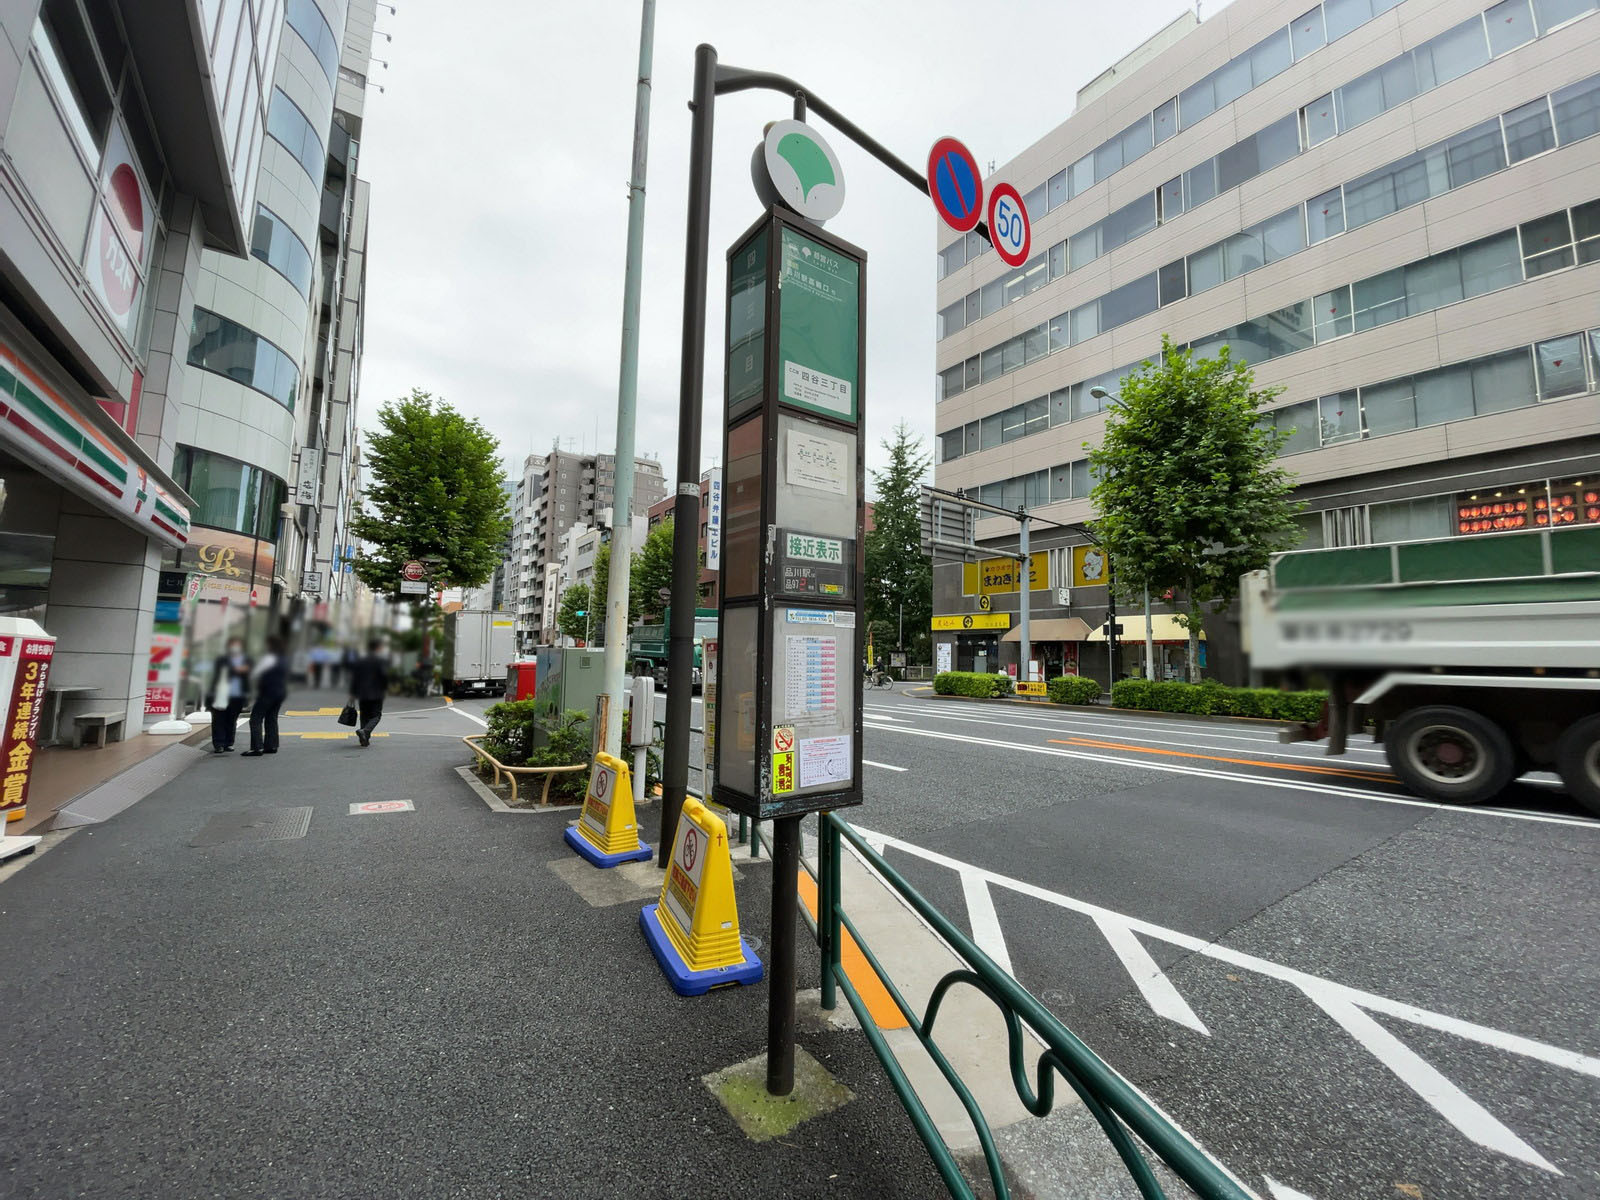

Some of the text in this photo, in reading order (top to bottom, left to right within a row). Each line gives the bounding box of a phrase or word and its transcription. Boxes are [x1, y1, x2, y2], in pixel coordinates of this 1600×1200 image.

[997, 199, 1022, 248] 50
[801, 371, 847, 394] 四谷三丁目
[789, 535, 840, 561] 接近表示
[983, 570, 1037, 587] まねきこ
[25, 643, 54, 656] お持ち帰り
[0, 661, 39, 809] 3年連続金賞
